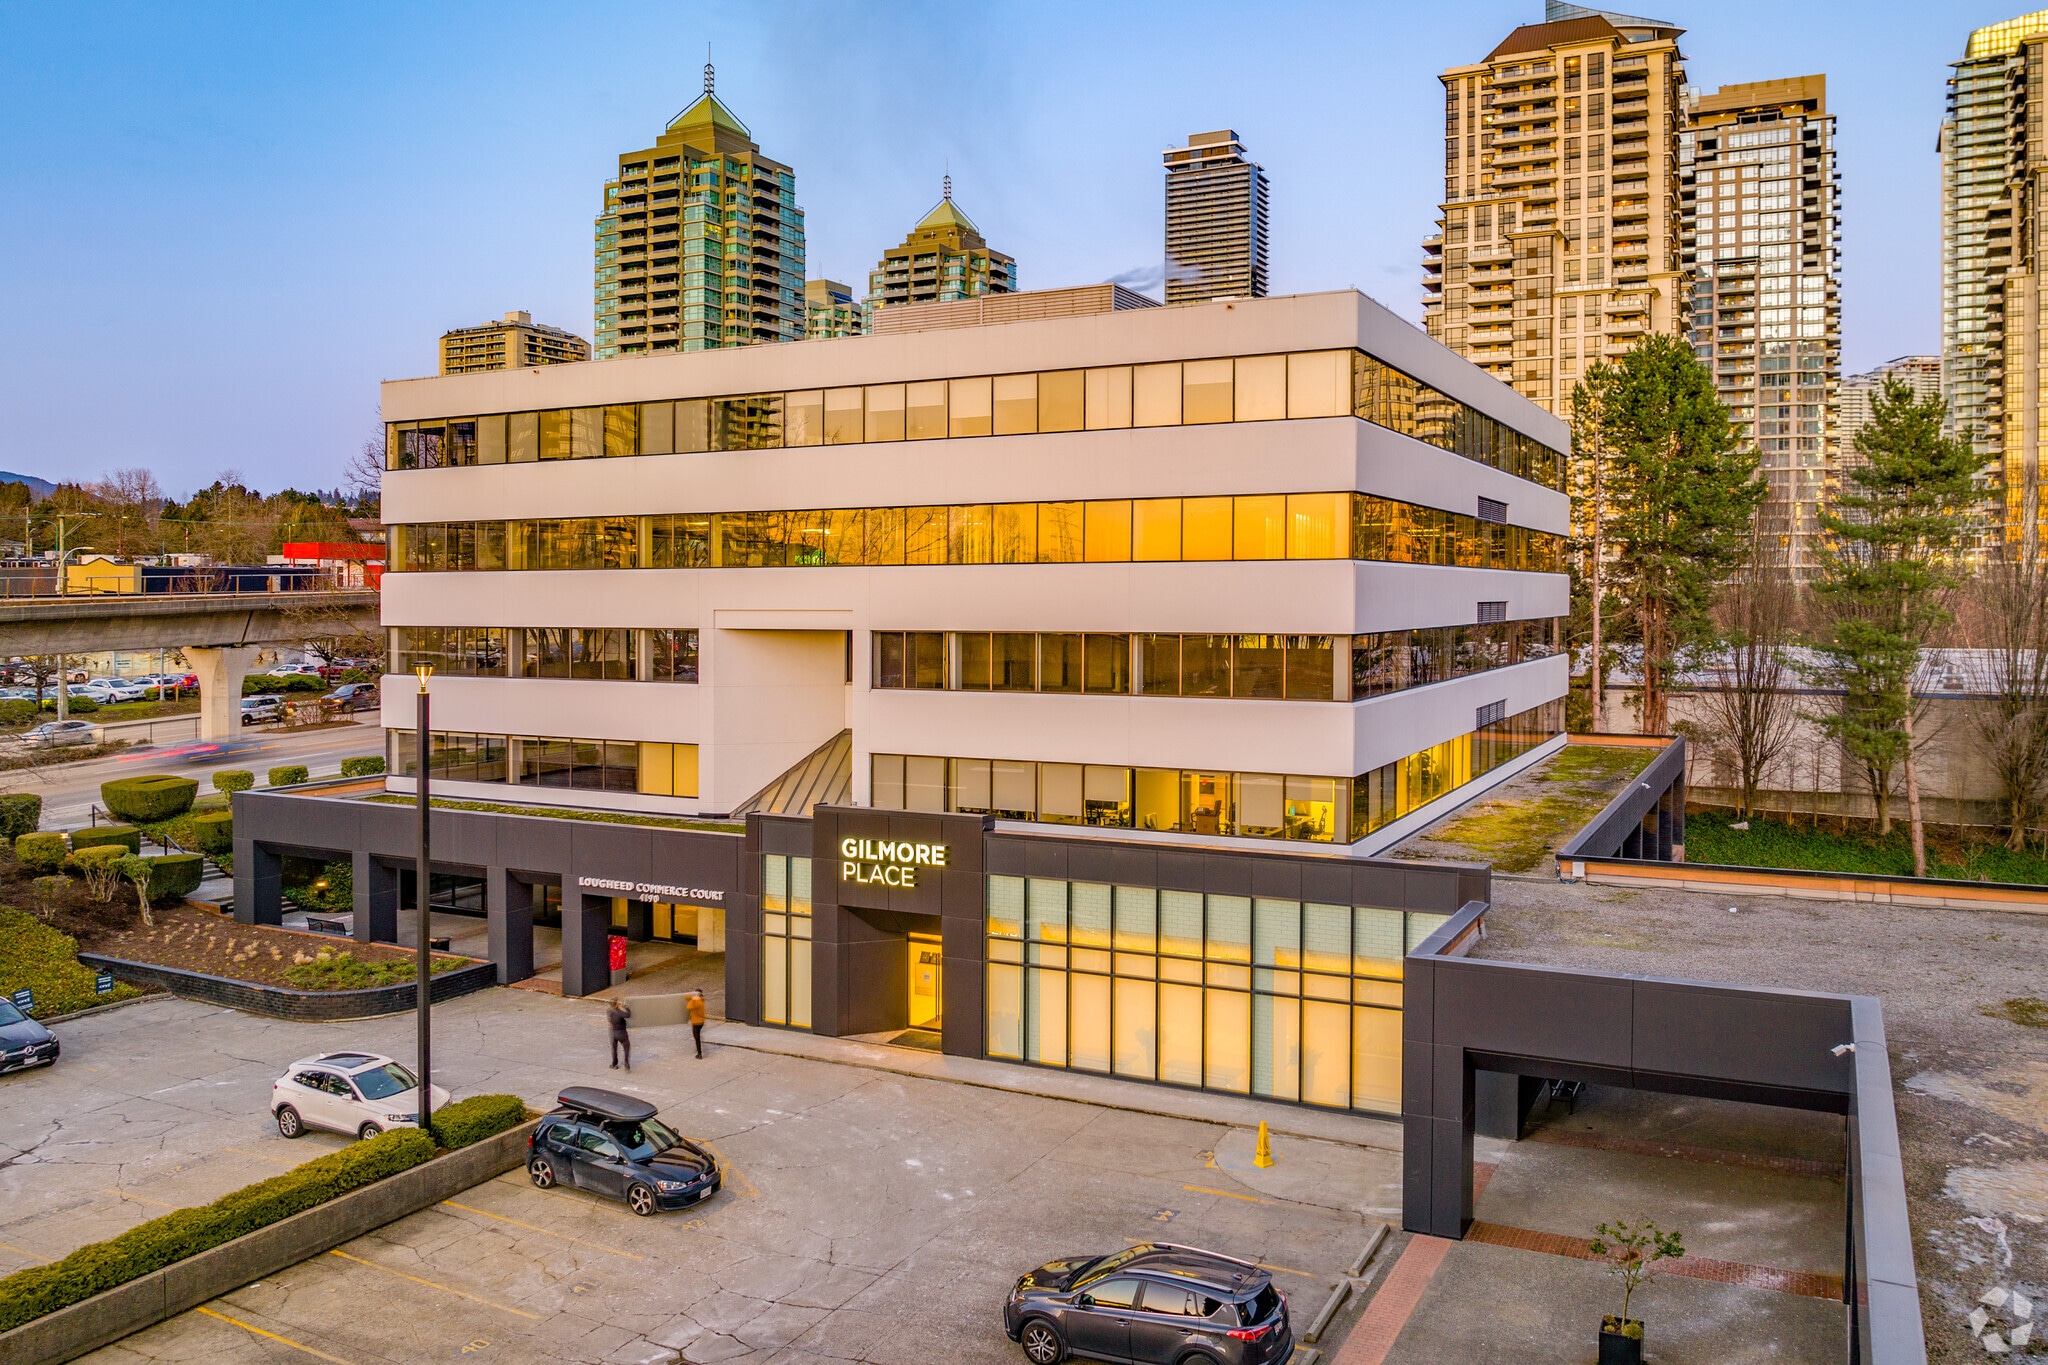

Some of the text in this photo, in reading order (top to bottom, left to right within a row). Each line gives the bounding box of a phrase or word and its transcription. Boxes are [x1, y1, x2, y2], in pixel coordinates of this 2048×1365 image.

[841, 838, 946, 866] GILMORE
[843, 861, 916, 888] PLACE
[578, 876, 724, 901] LOUGHEED COMMERCE COURT
[638, 893, 660, 903] 4190
[461, 1339, 491, 1354] 40
